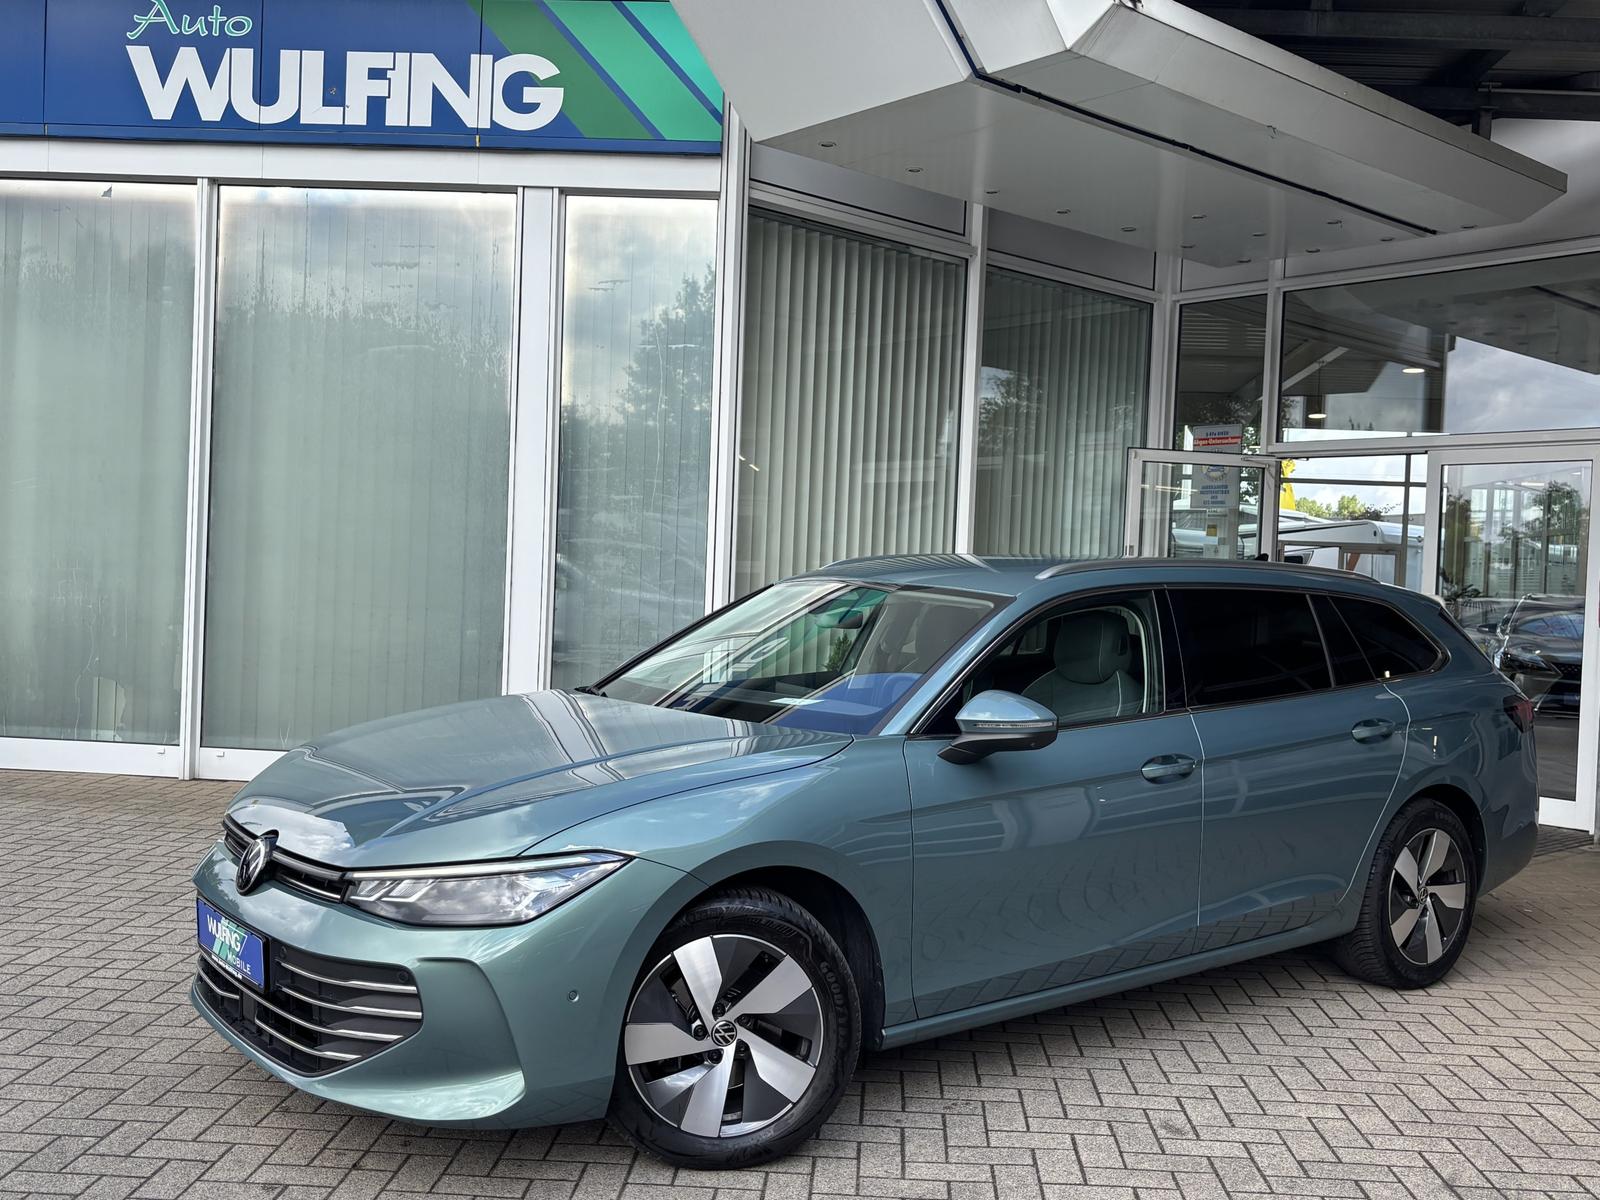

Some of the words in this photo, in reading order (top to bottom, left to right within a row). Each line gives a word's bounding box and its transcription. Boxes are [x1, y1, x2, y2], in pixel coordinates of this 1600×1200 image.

[126, 0, 253, 40] Auto
[125, 45, 565, 131] WULFING
[227, 948, 252, 976] MOBILE
